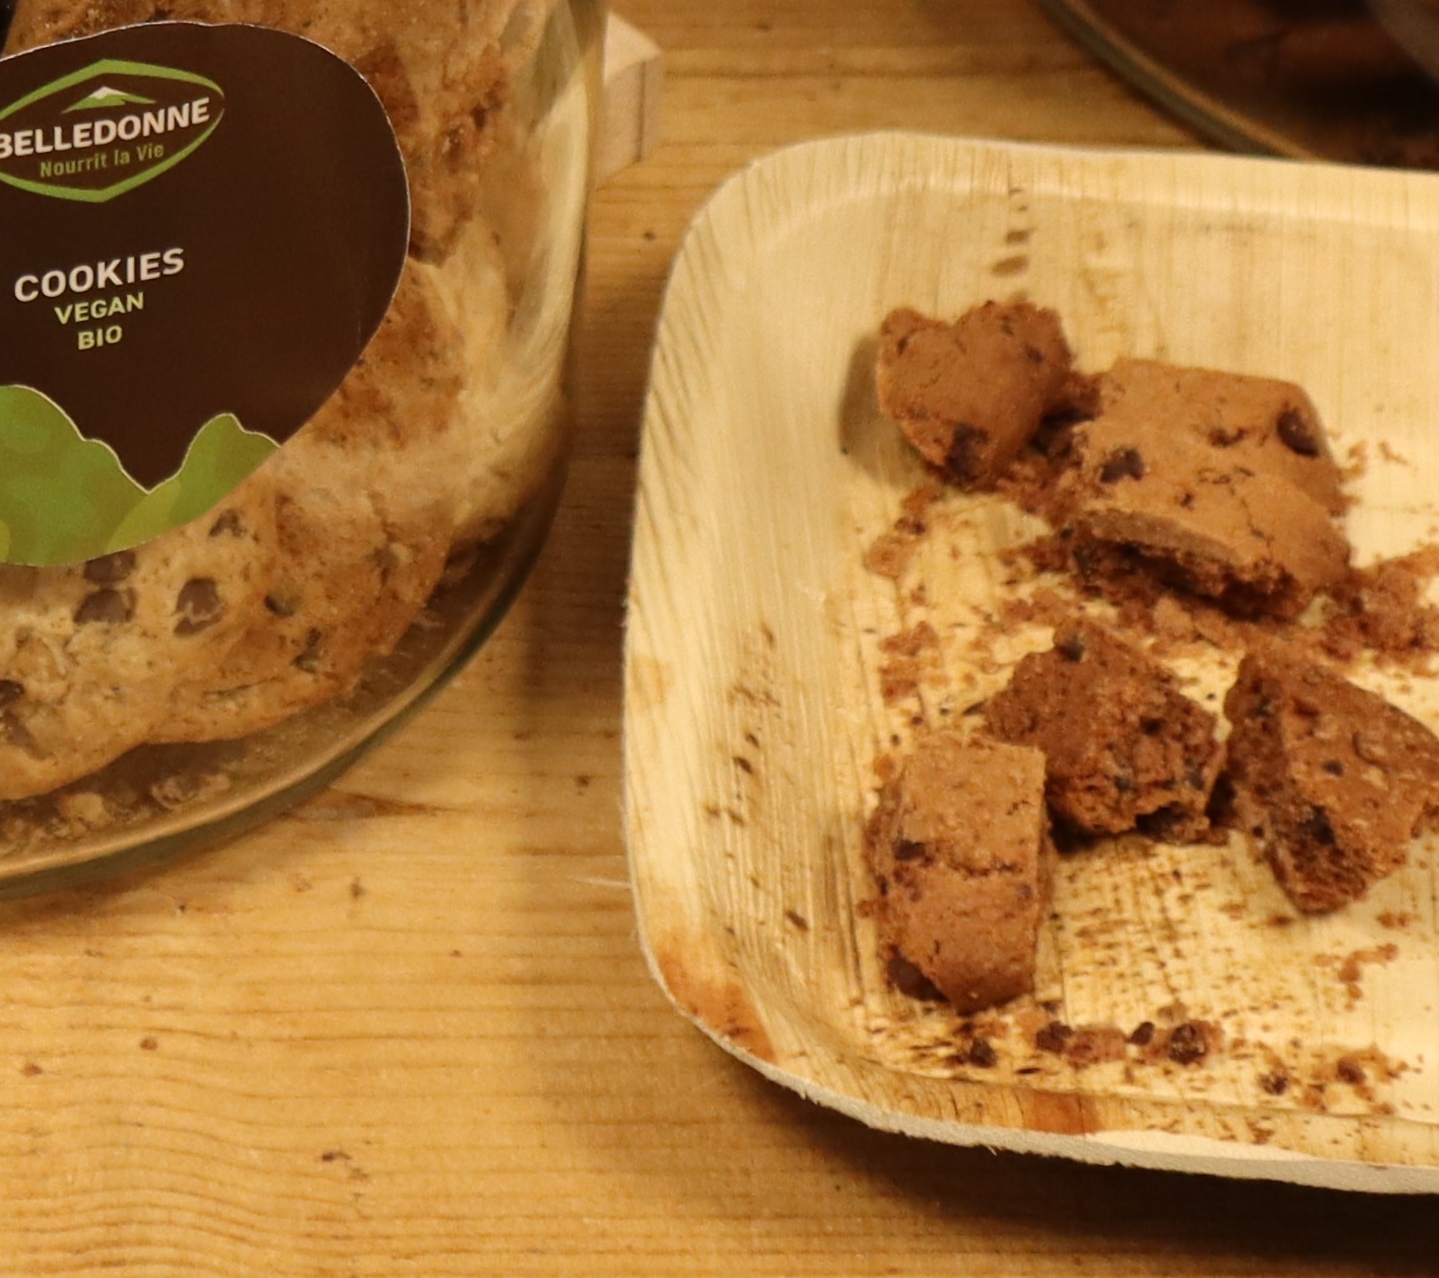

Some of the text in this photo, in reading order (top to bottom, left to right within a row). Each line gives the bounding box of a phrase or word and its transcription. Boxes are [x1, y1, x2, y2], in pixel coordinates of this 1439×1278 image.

[38, 143, 165, 179] Nourrit la Vie
[13, 246, 187, 304] COOKIES
[54, 291, 146, 327] VEGAN
[77, 325, 124, 352] BIO
